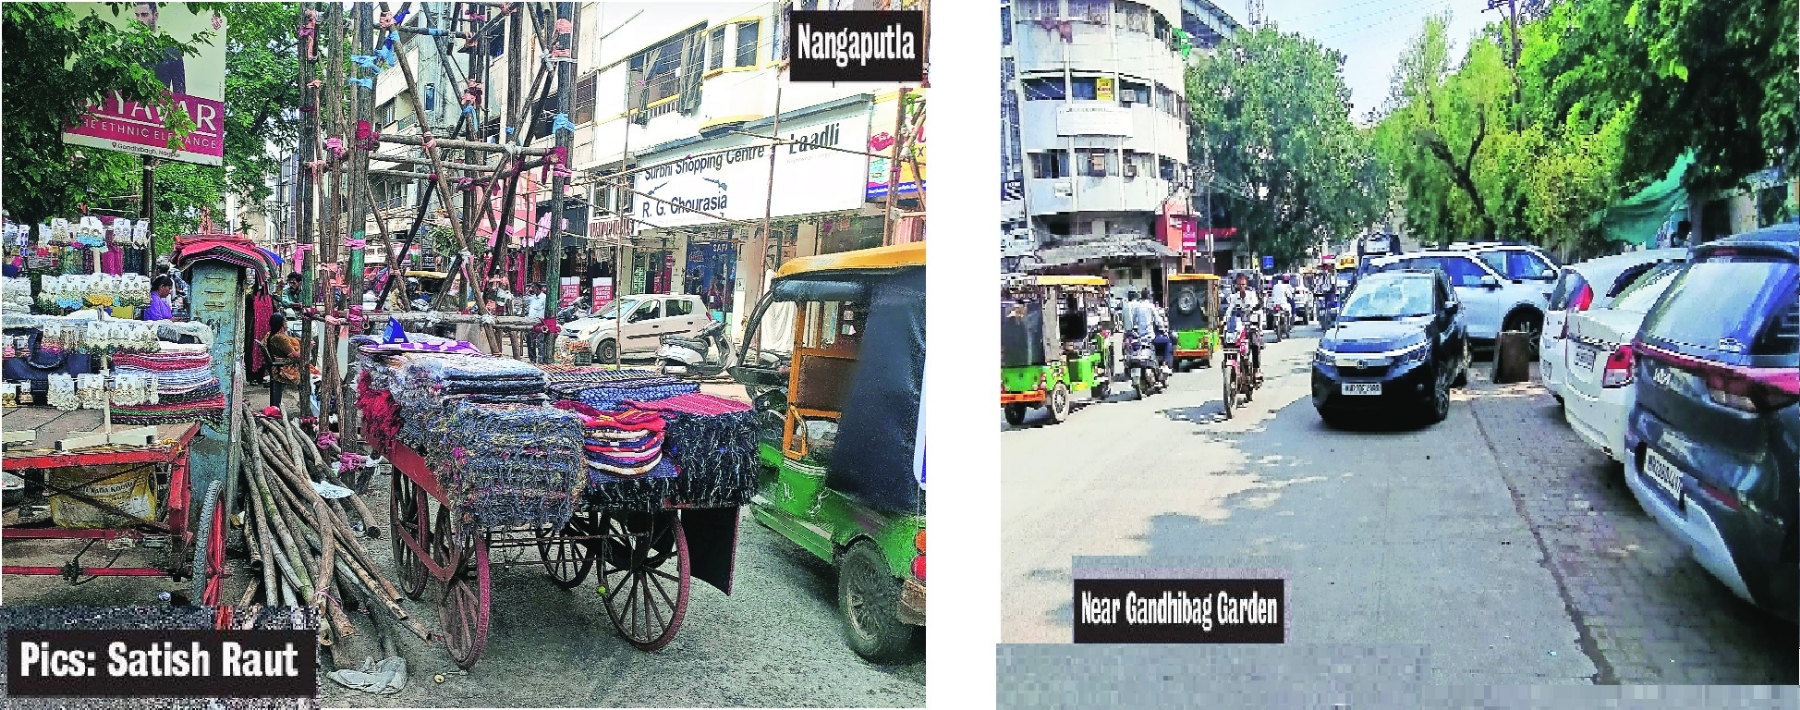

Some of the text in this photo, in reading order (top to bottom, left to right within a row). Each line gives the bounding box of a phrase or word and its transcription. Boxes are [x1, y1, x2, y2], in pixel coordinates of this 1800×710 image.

[82, 117, 97, 129] HE
[101, 120, 150, 138] ETHNIC
[789, 122, 840, 155] Laadli
[644, 146, 765, 181] Surbhi Shopping Centre
[642, 191, 728, 218] R. G. Chourasia
